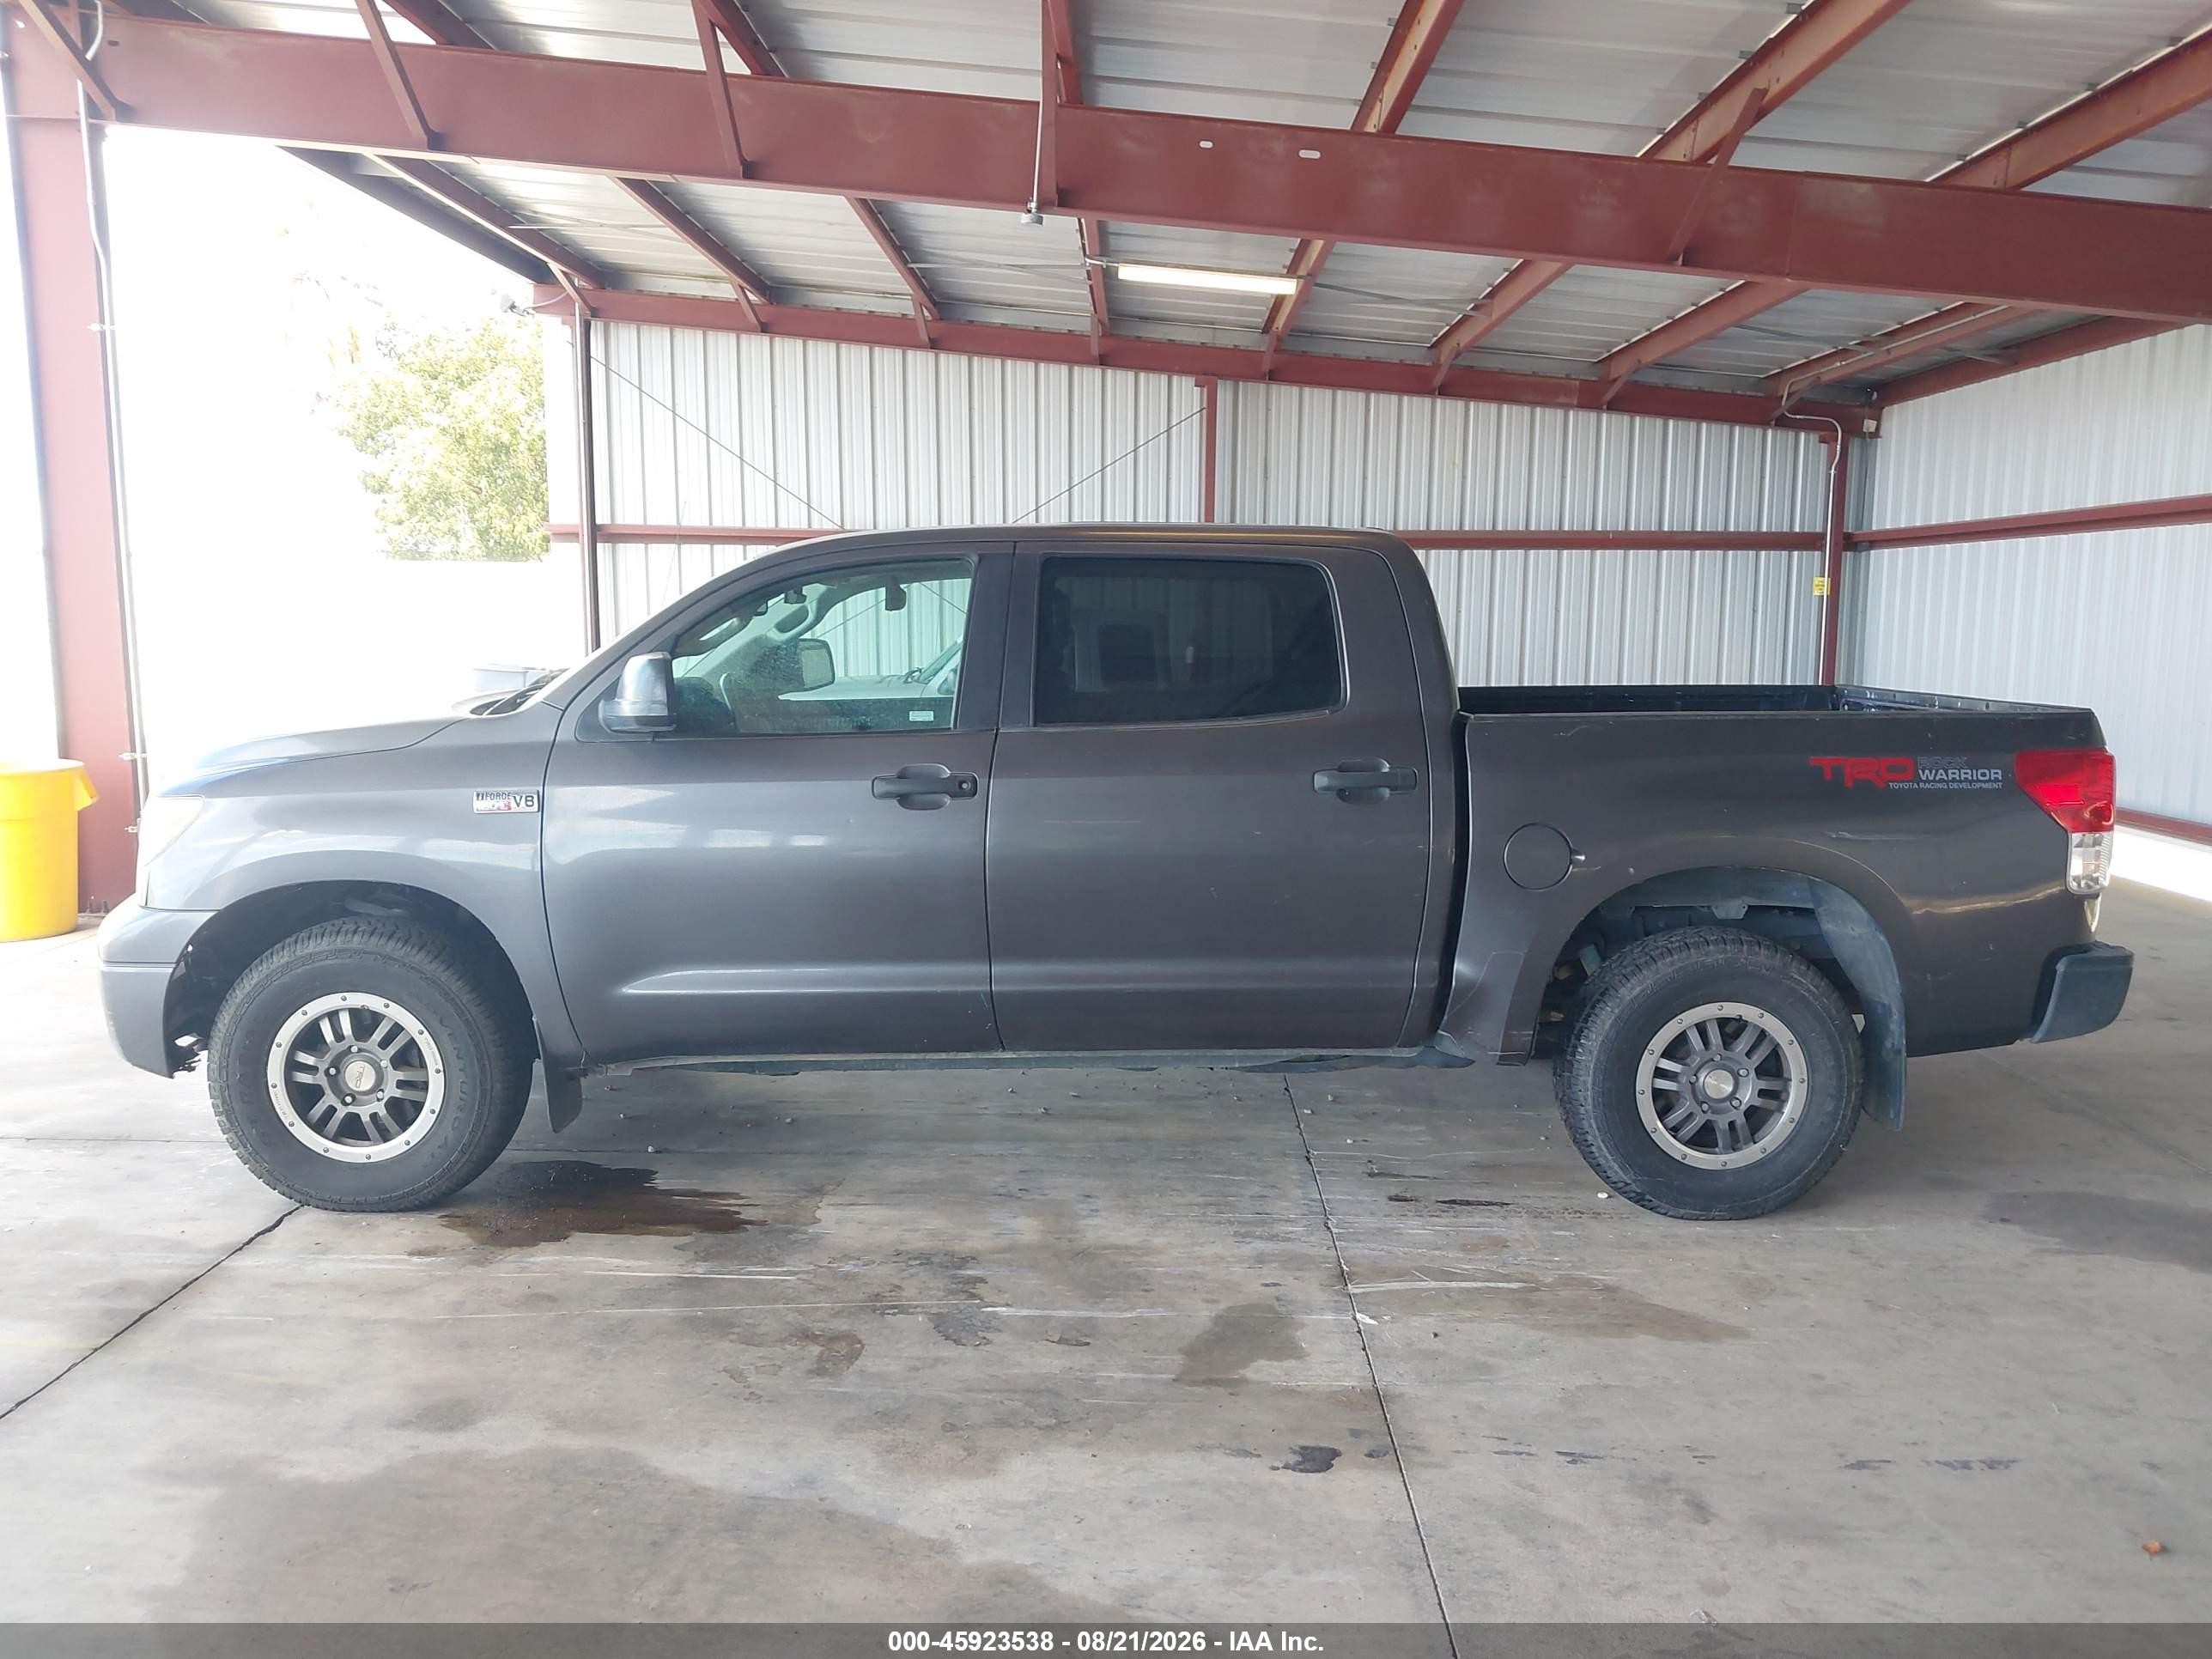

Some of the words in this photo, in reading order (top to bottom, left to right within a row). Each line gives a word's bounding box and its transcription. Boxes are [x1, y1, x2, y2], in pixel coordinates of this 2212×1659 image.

[1917, 757, 1968, 769] ROCK
[1809, 756, 1914, 788] TRD
[1918, 769, 2002, 780] WARRIOR
[513, 795, 534, 807] V8
